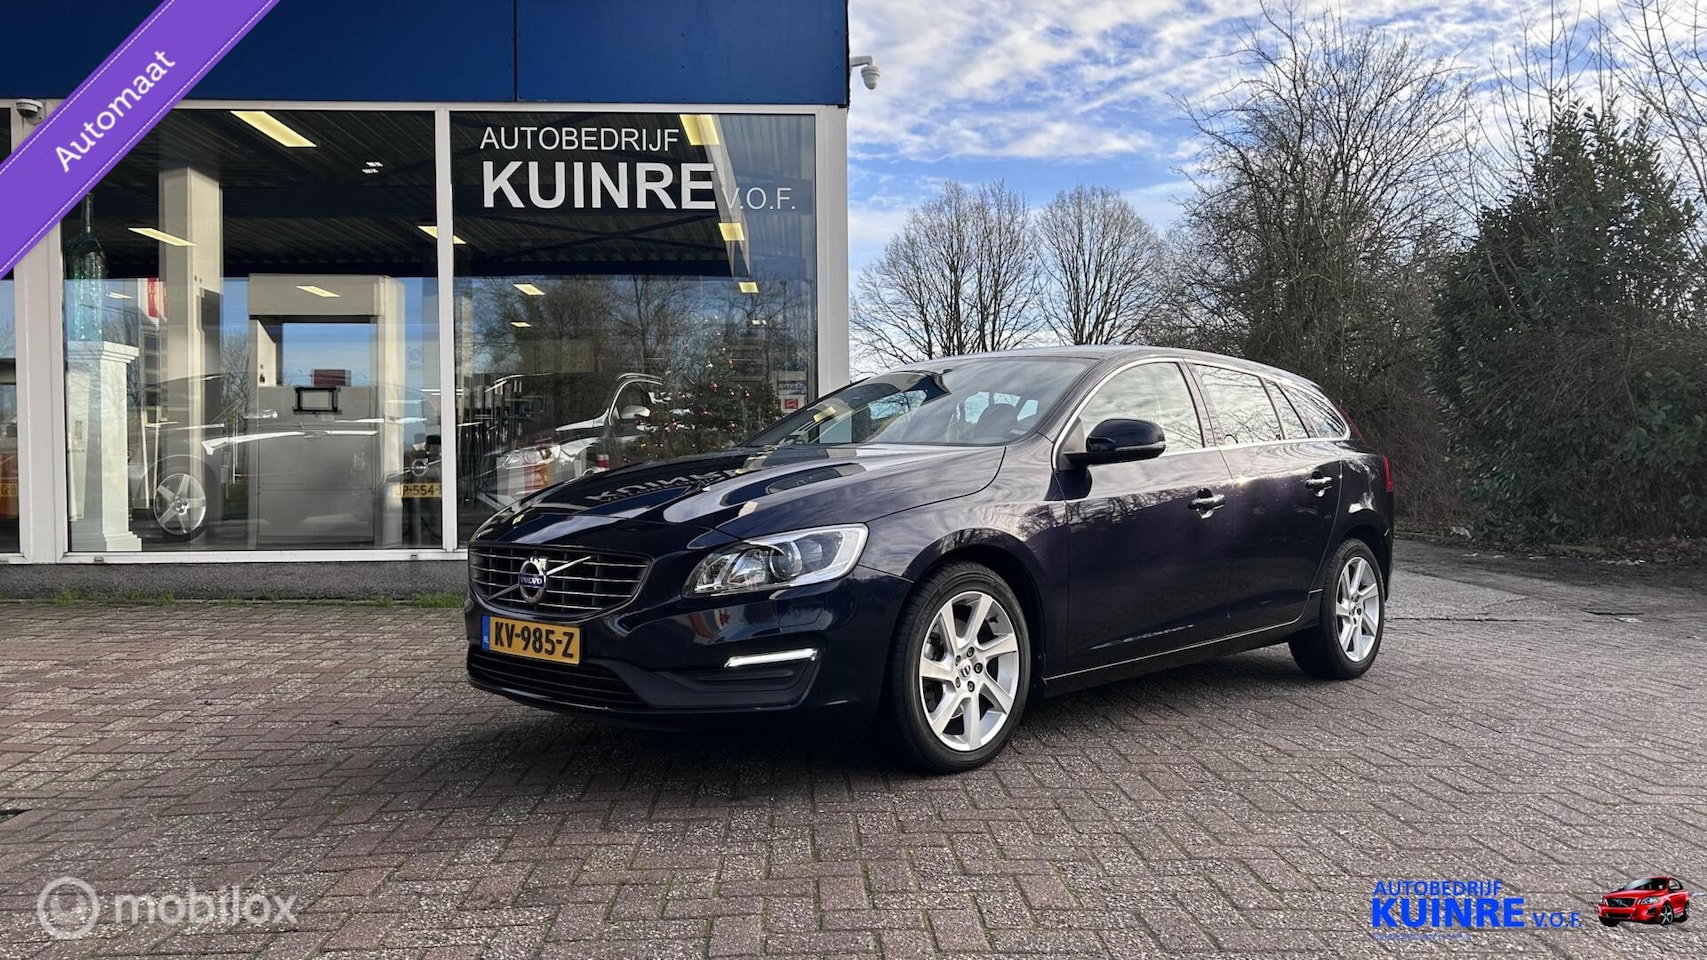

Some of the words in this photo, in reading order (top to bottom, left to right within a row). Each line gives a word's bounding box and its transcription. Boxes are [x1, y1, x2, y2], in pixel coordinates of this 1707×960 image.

[480, 126, 679, 152] AUTOBEDRIJF
[482, 160, 716, 210] KUINRE
[721, 186, 796, 210] V.O.F.
[494, 621, 575, 659] KV-985-Z
